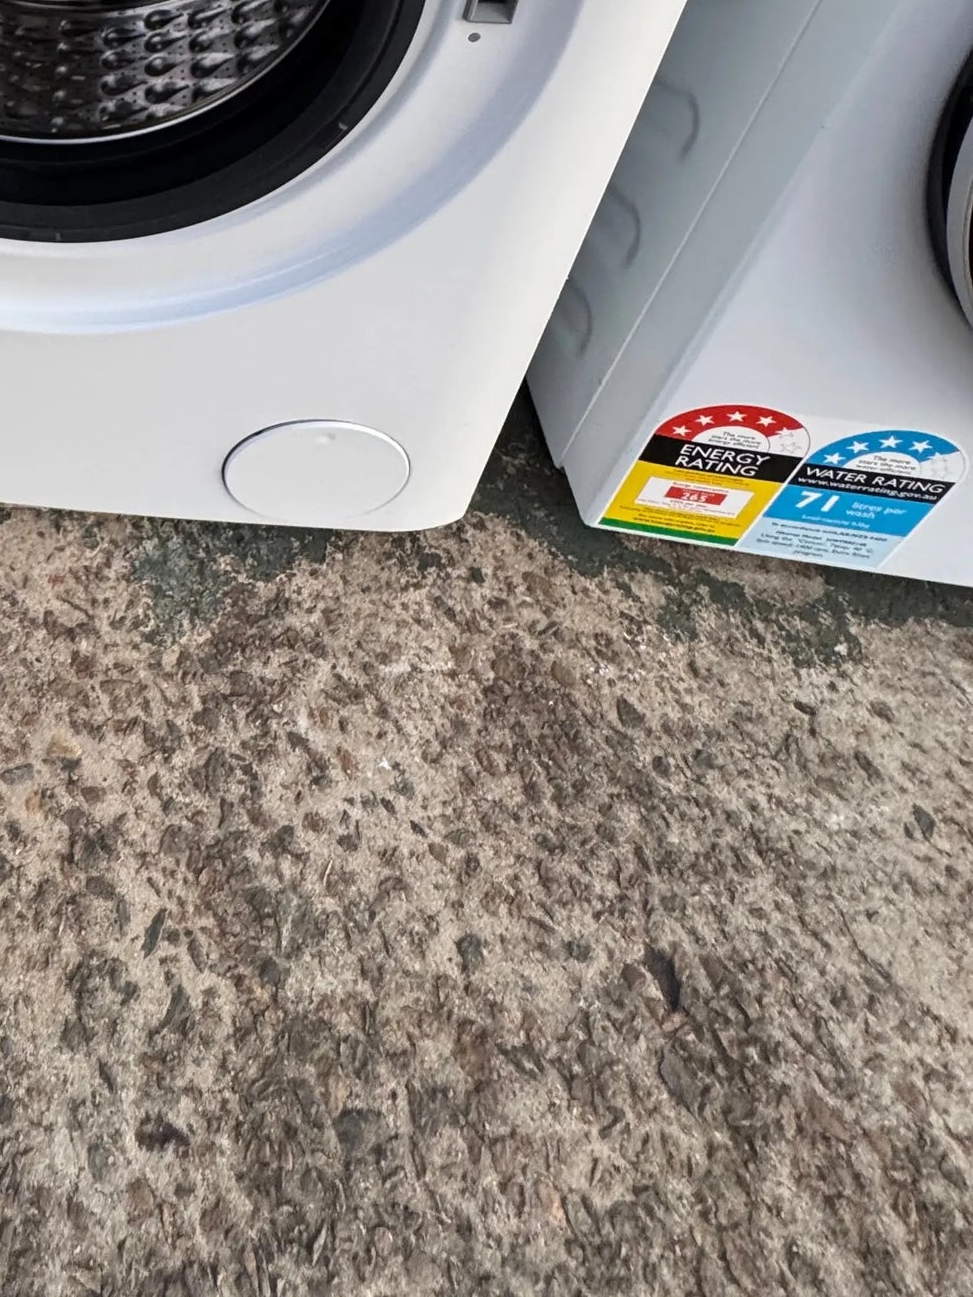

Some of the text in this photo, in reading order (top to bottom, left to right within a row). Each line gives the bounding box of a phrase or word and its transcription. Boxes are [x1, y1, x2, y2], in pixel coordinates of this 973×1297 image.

[680, 444, 771, 466] ENERGY
[675, 457, 759, 477] RATING
[797, 477, 939, 501] www.waterrating.gov.au
[806, 466, 947, 493] WATER RATING
[681, 492, 708, 503] 265
[795, 490, 839, 512] 71
